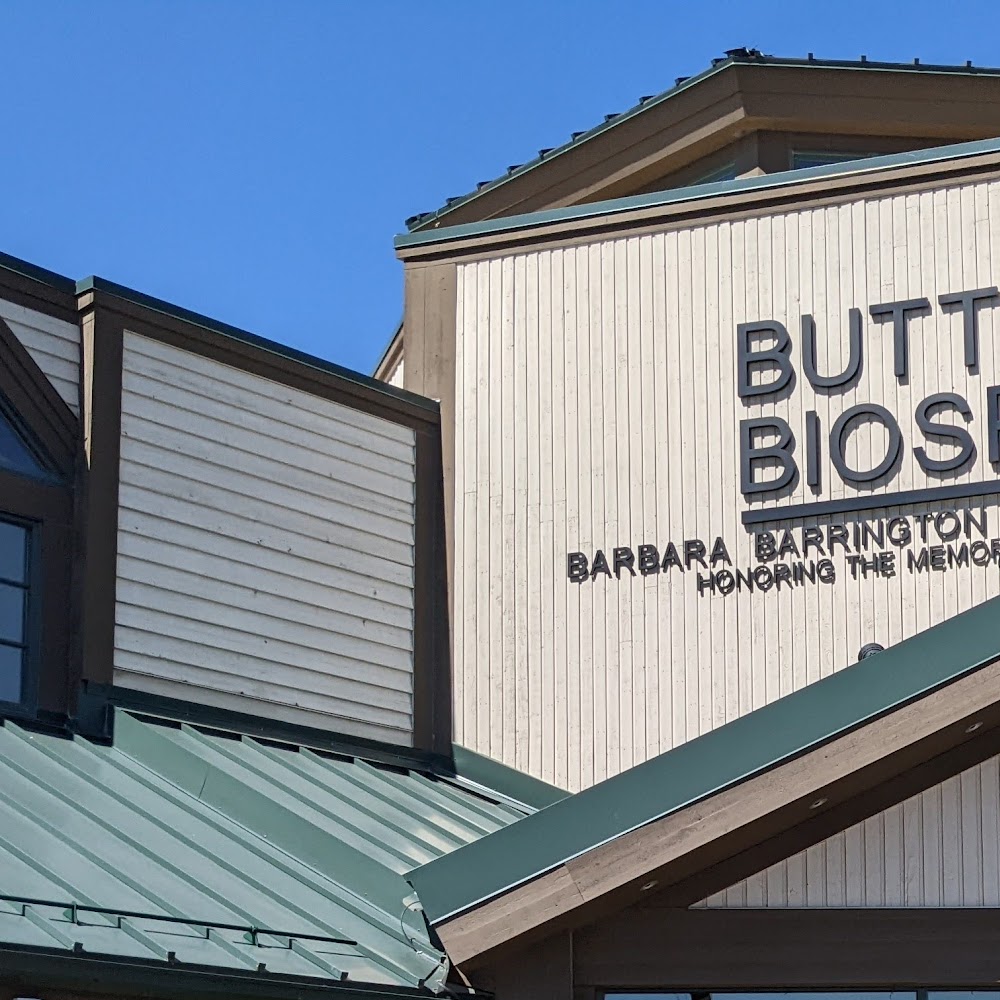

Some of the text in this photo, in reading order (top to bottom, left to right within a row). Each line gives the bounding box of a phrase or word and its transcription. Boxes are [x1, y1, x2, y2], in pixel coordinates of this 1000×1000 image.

[567, 537, 732, 582] BARBARA
[755, 507, 988, 560] BARRINGTON
[697, 558, 835, 597] HONORING
[846, 551, 895, 579] THE
